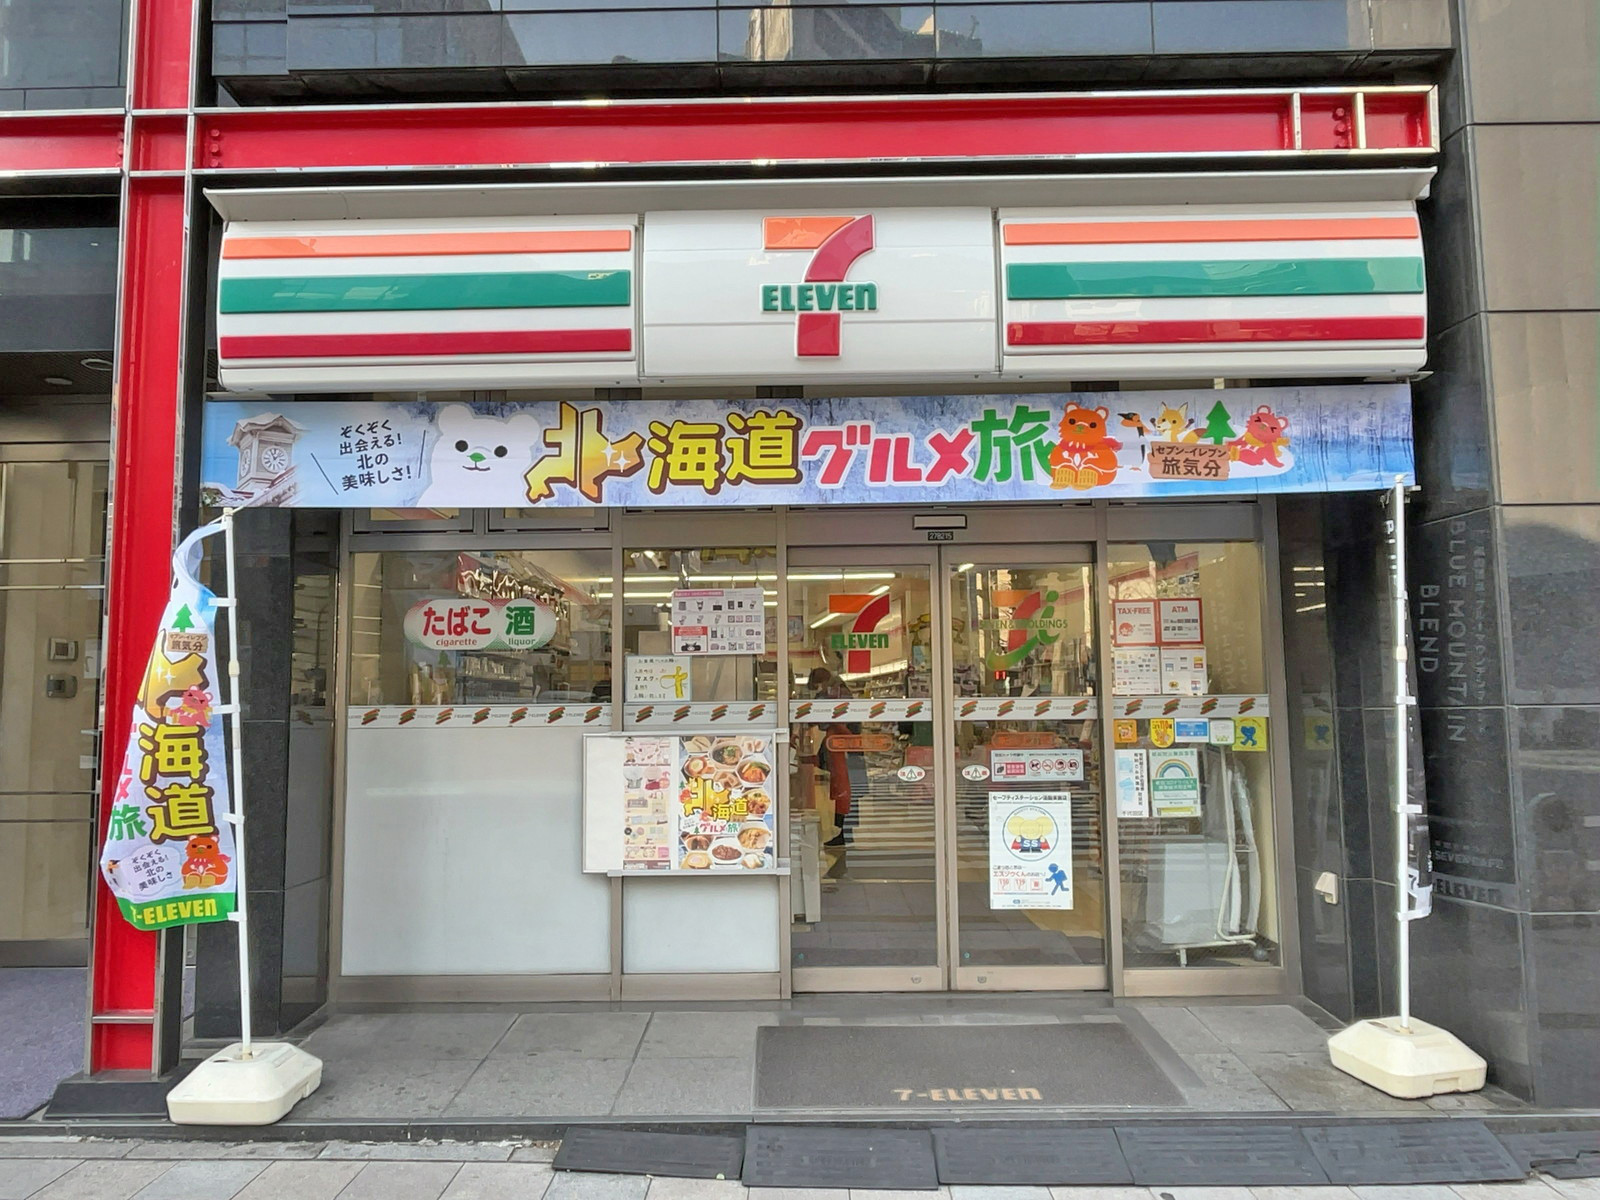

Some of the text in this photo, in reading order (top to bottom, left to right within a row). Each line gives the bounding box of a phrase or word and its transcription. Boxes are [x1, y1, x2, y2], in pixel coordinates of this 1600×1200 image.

[340, 419, 392, 438] ぞくぞく
[357, 453, 389, 470] 北の
[1161, 457, 1222, 479] 旅気分
[422, 606, 491, 637] たばこ
[505, 606, 536, 636] 酒
[1419, 584, 1441, 673] BLEND
[436, 637, 478, 647] cigarette
[508, 637, 536, 647] liquor
